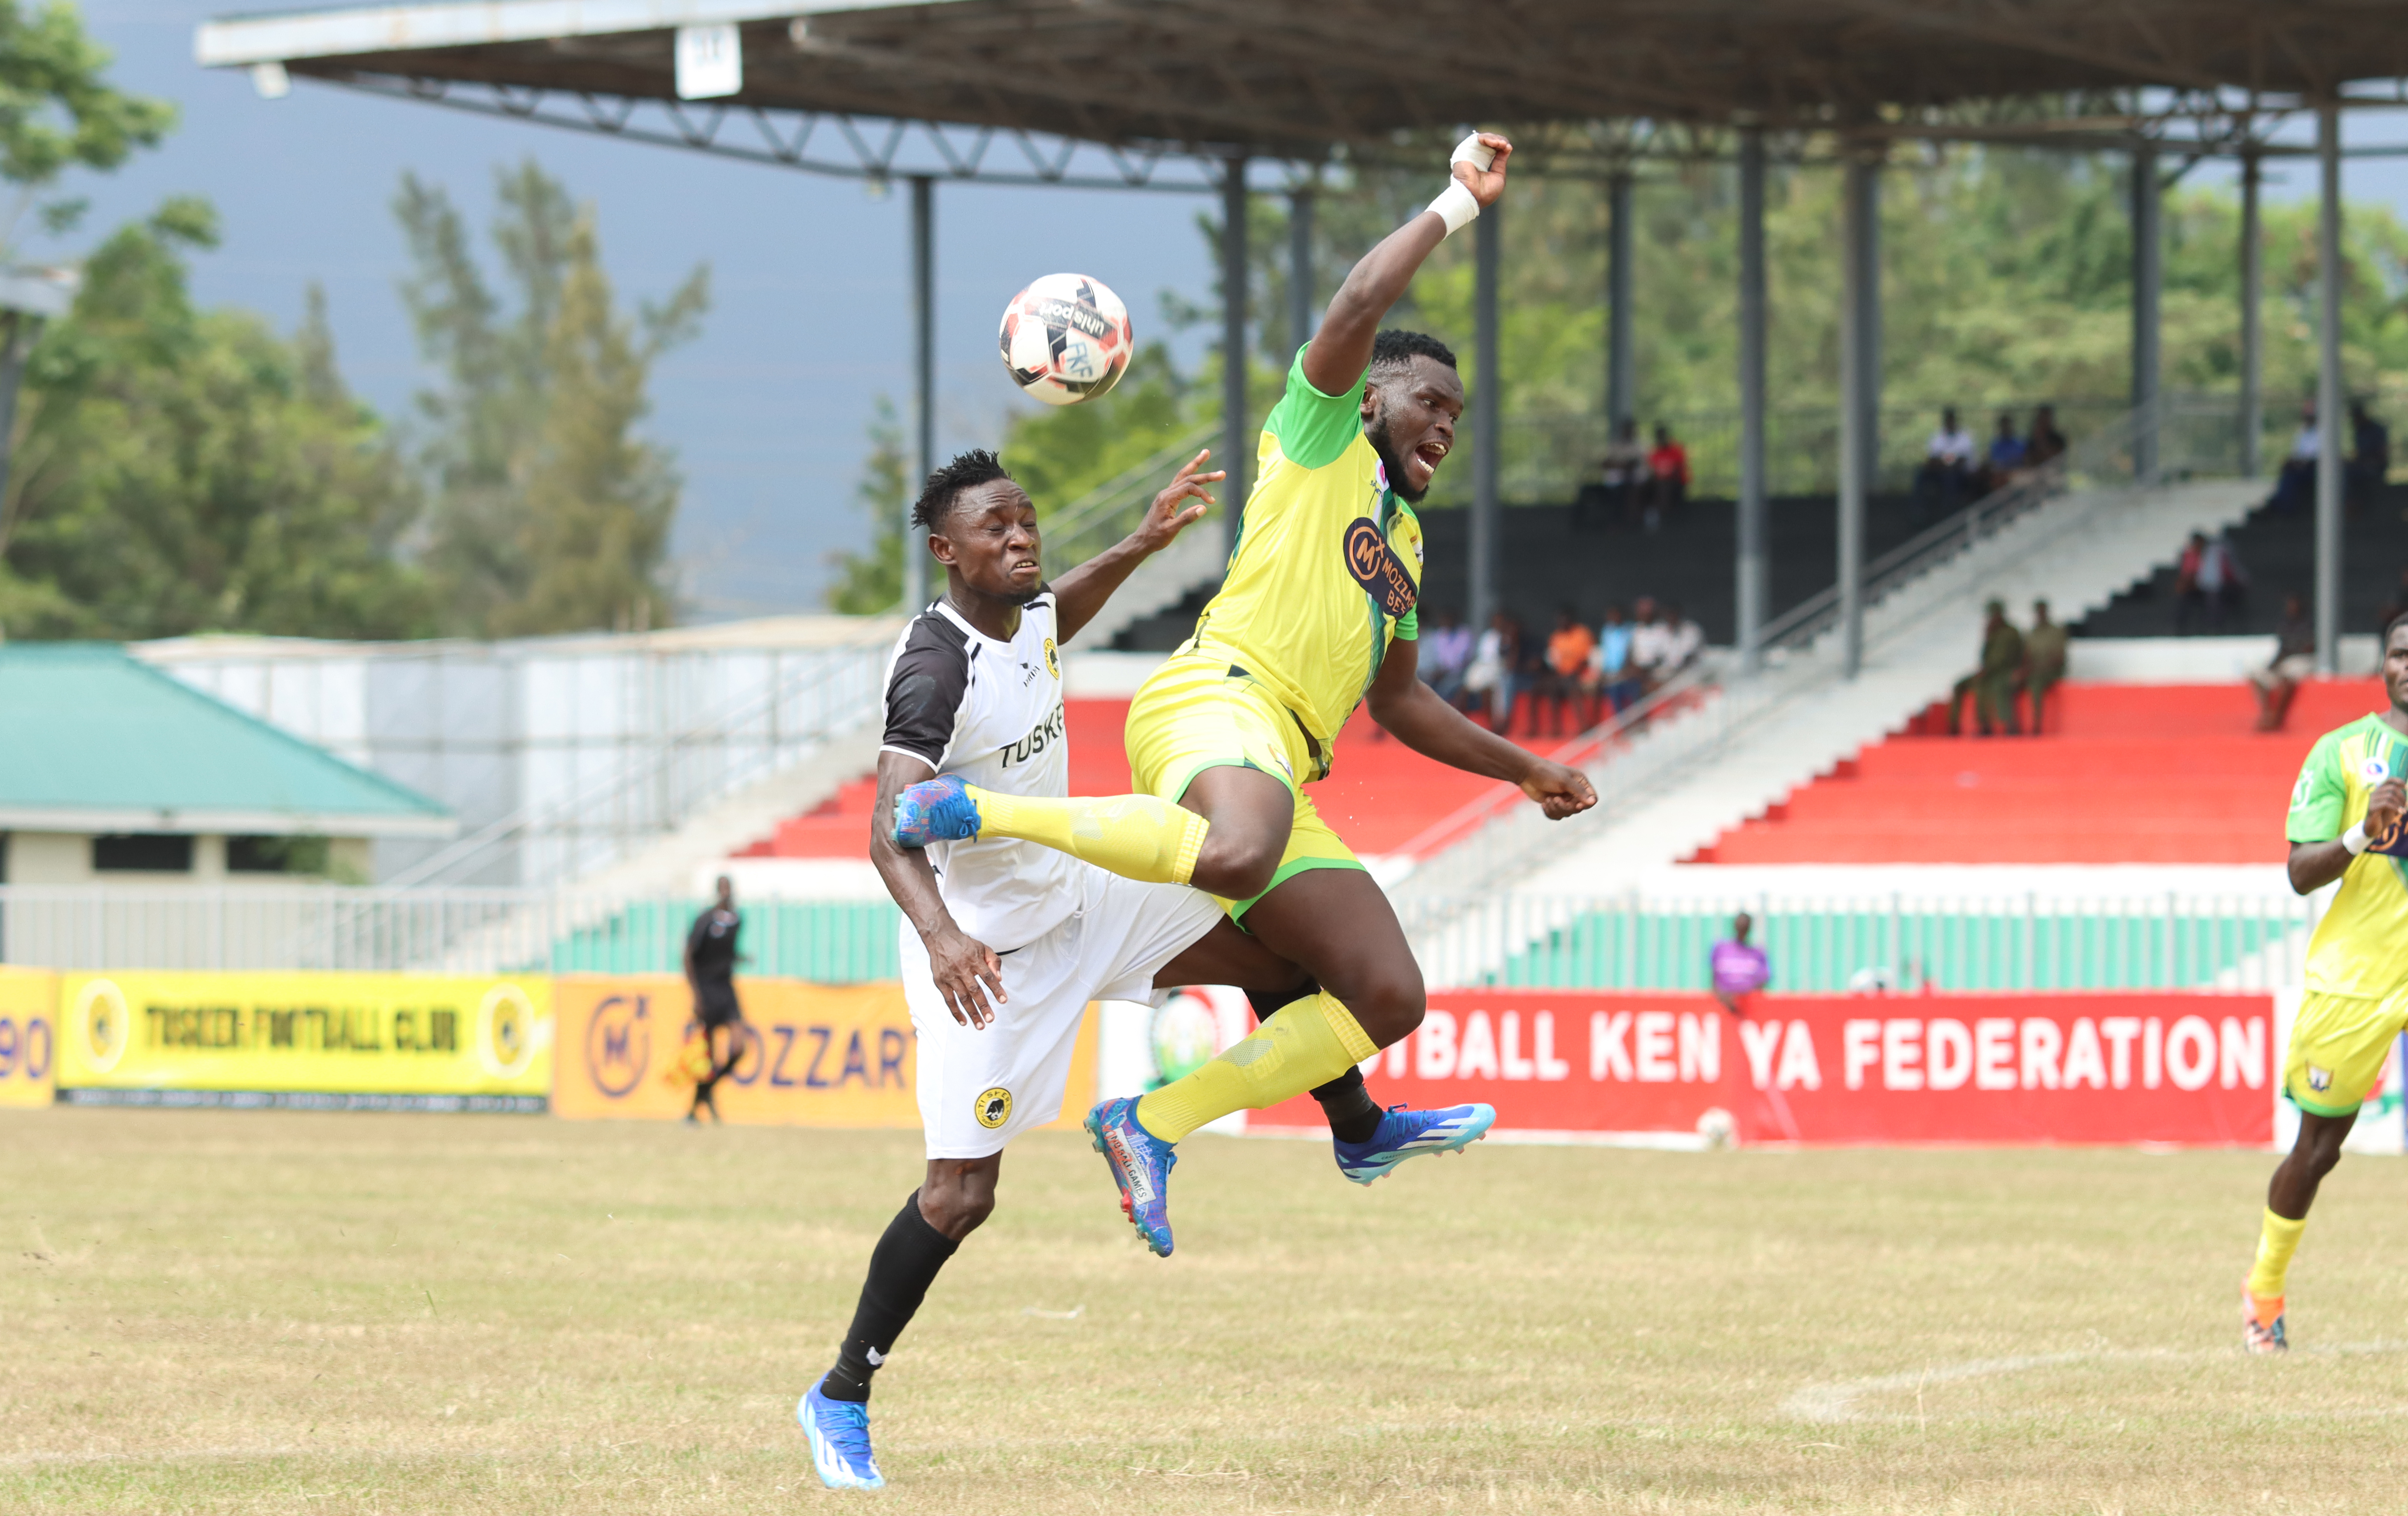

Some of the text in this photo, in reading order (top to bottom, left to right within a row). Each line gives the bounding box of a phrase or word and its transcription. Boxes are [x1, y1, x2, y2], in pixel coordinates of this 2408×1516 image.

[1382, 557, 1416, 608] MOZZAR
[998, 701, 1064, 769] TUSKE
[685, 1025, 918, 1090] OZZAR
[1356, 1009, 1570, 1081] BALL
[1843, 1014, 2266, 1093] FEDERATION
[1129, 1169, 1147, 1198] GAMES
